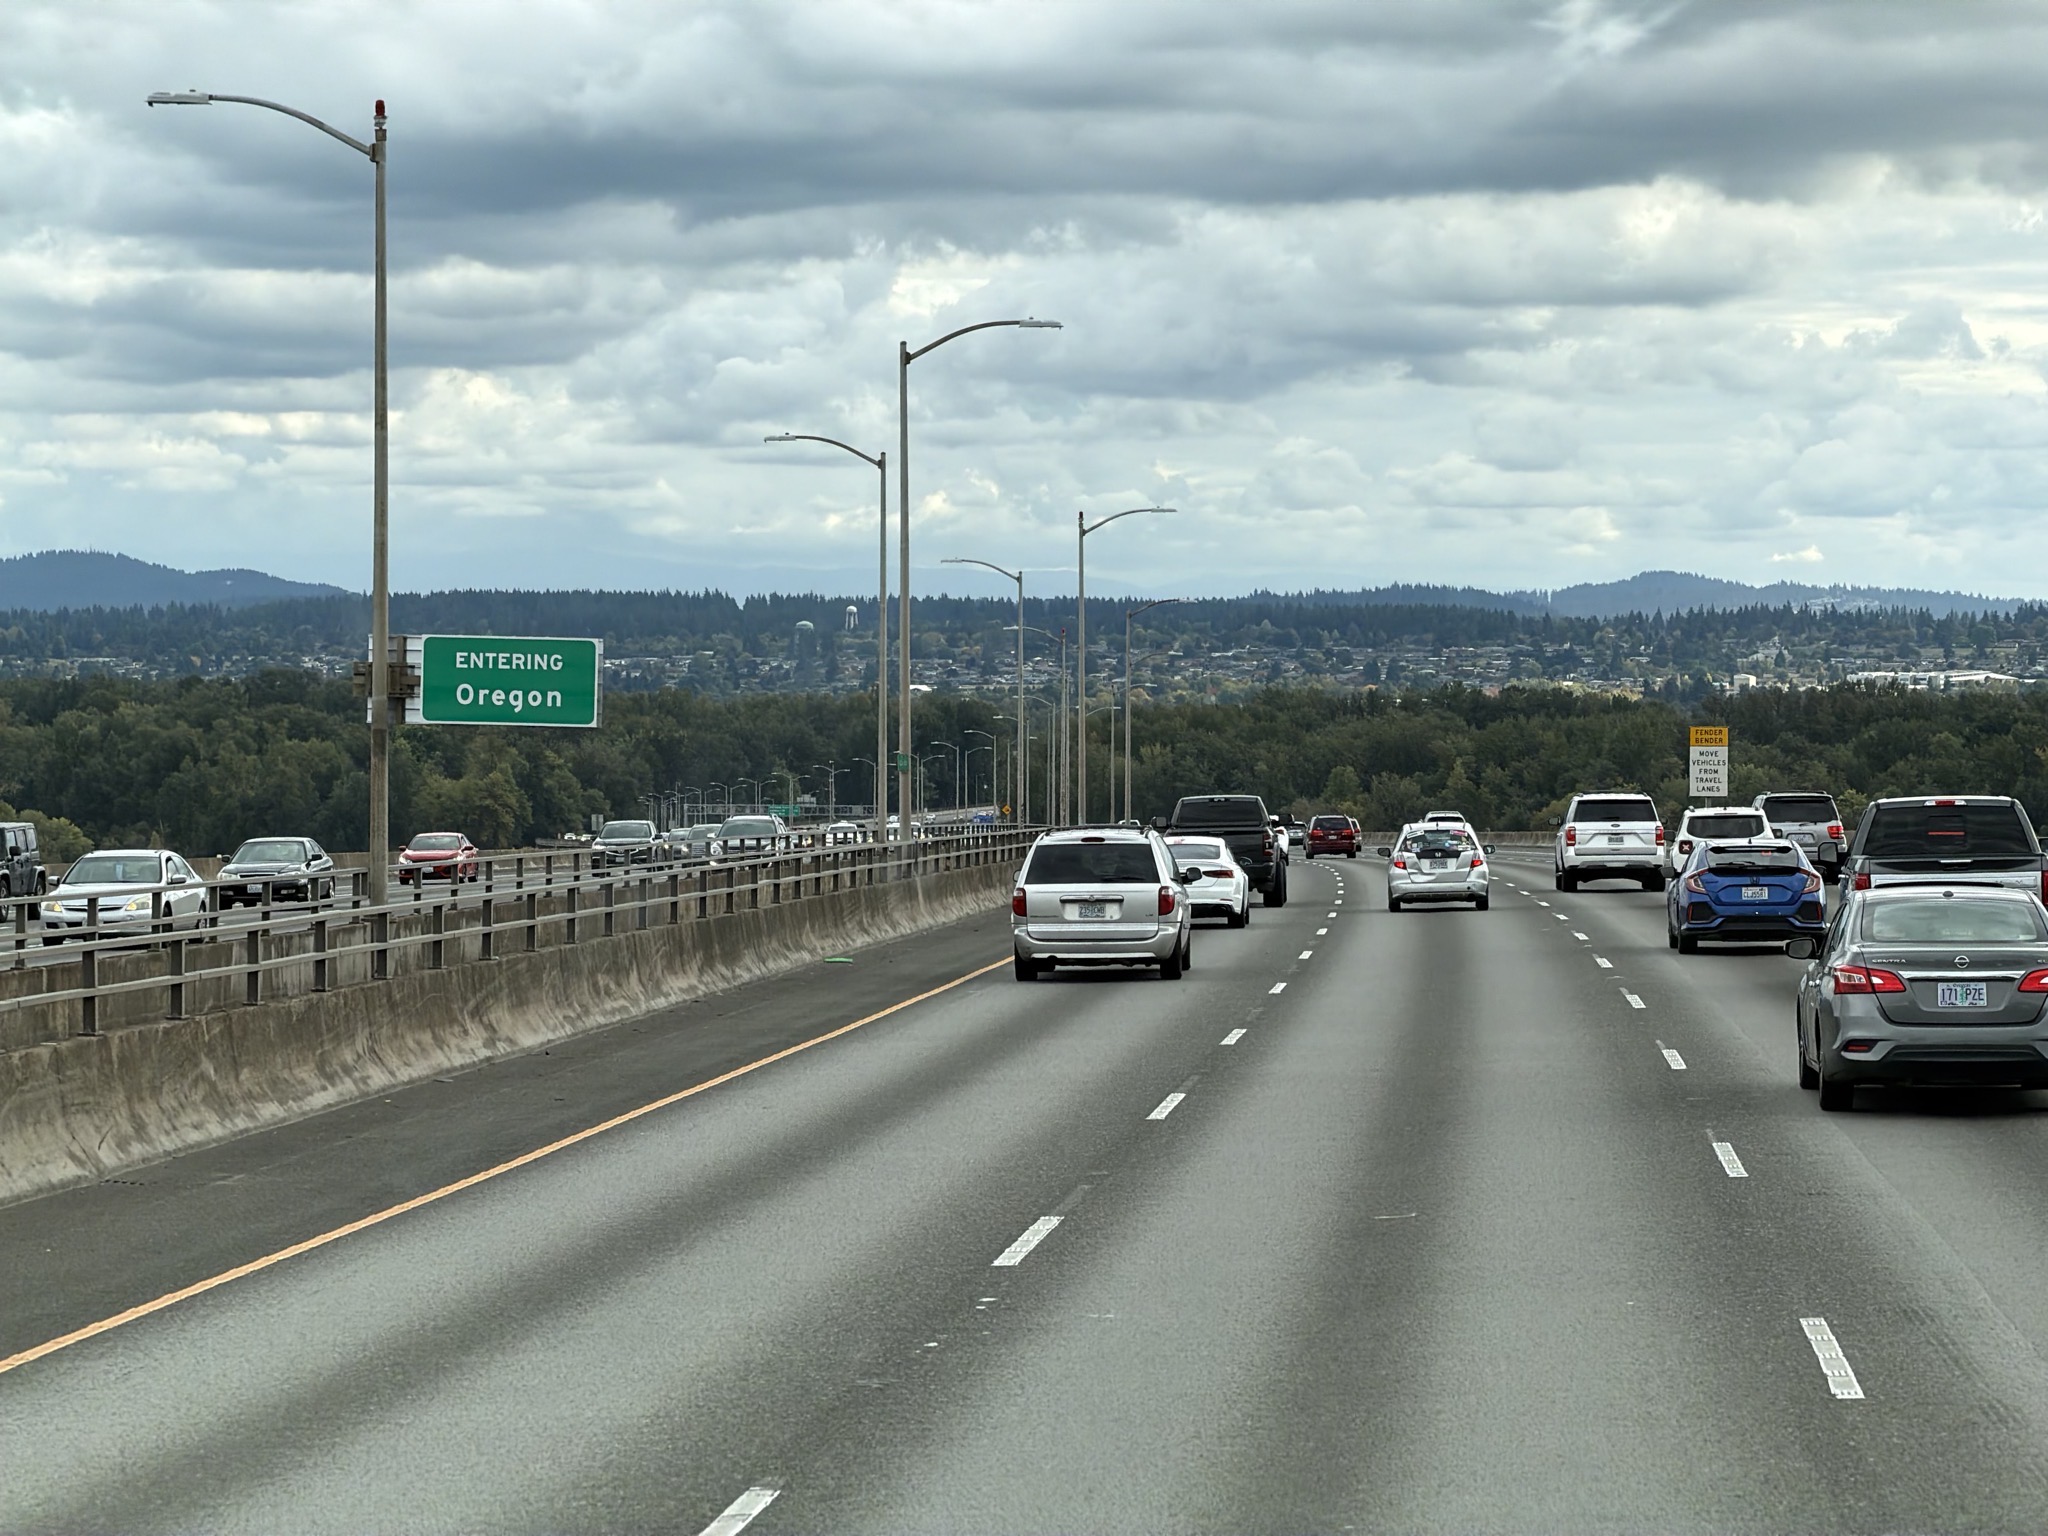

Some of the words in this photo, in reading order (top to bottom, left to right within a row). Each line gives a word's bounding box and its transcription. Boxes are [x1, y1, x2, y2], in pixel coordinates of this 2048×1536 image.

[455, 651, 564, 671] ENTERING
[455, 683, 562, 713] Oregon
[1941, 988, 1958, 1001] 171
[1965, 987, 1985, 1001] PZE
